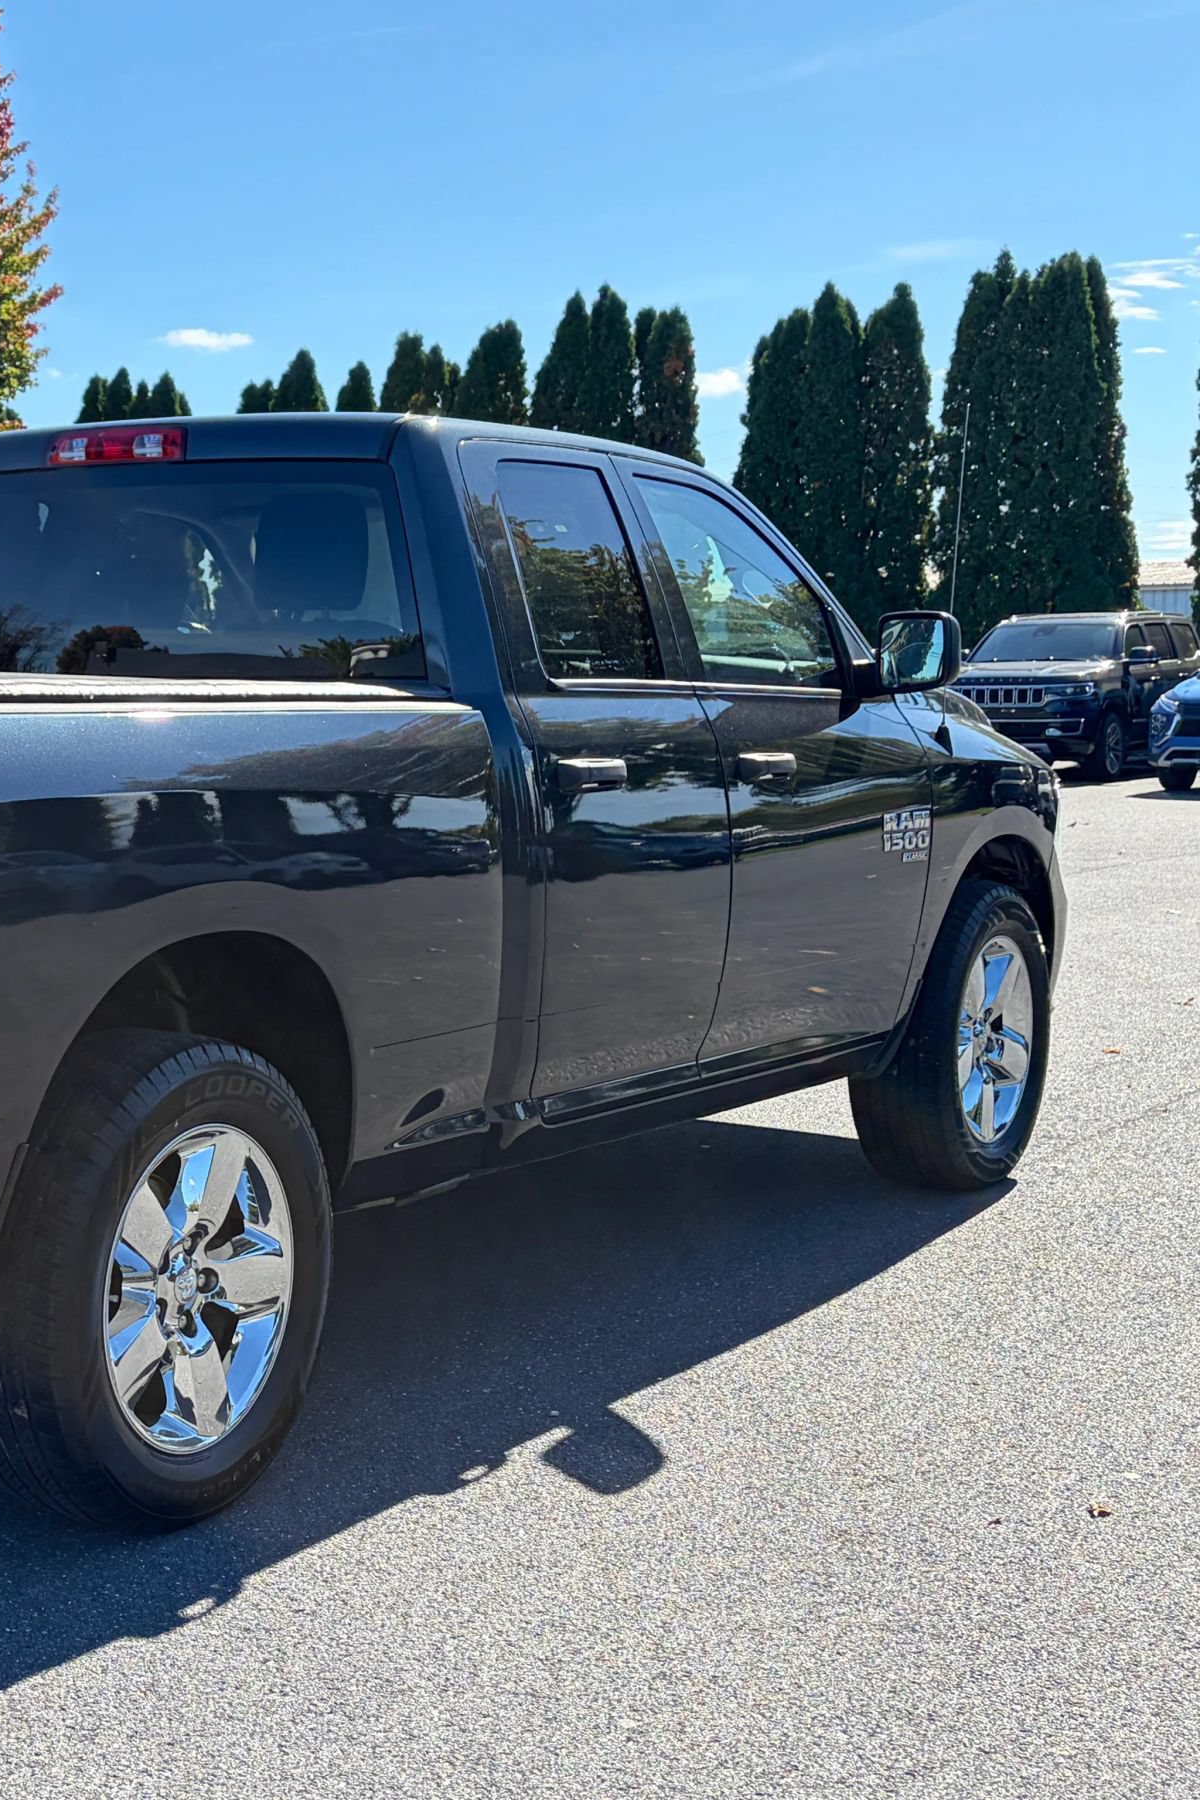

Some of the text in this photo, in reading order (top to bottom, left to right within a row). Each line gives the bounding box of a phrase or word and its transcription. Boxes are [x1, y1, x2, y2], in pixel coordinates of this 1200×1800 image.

[883, 811, 930, 832] RAM
[883, 831, 930, 852] 1500
[184, 1075, 301, 1131] COOPER
